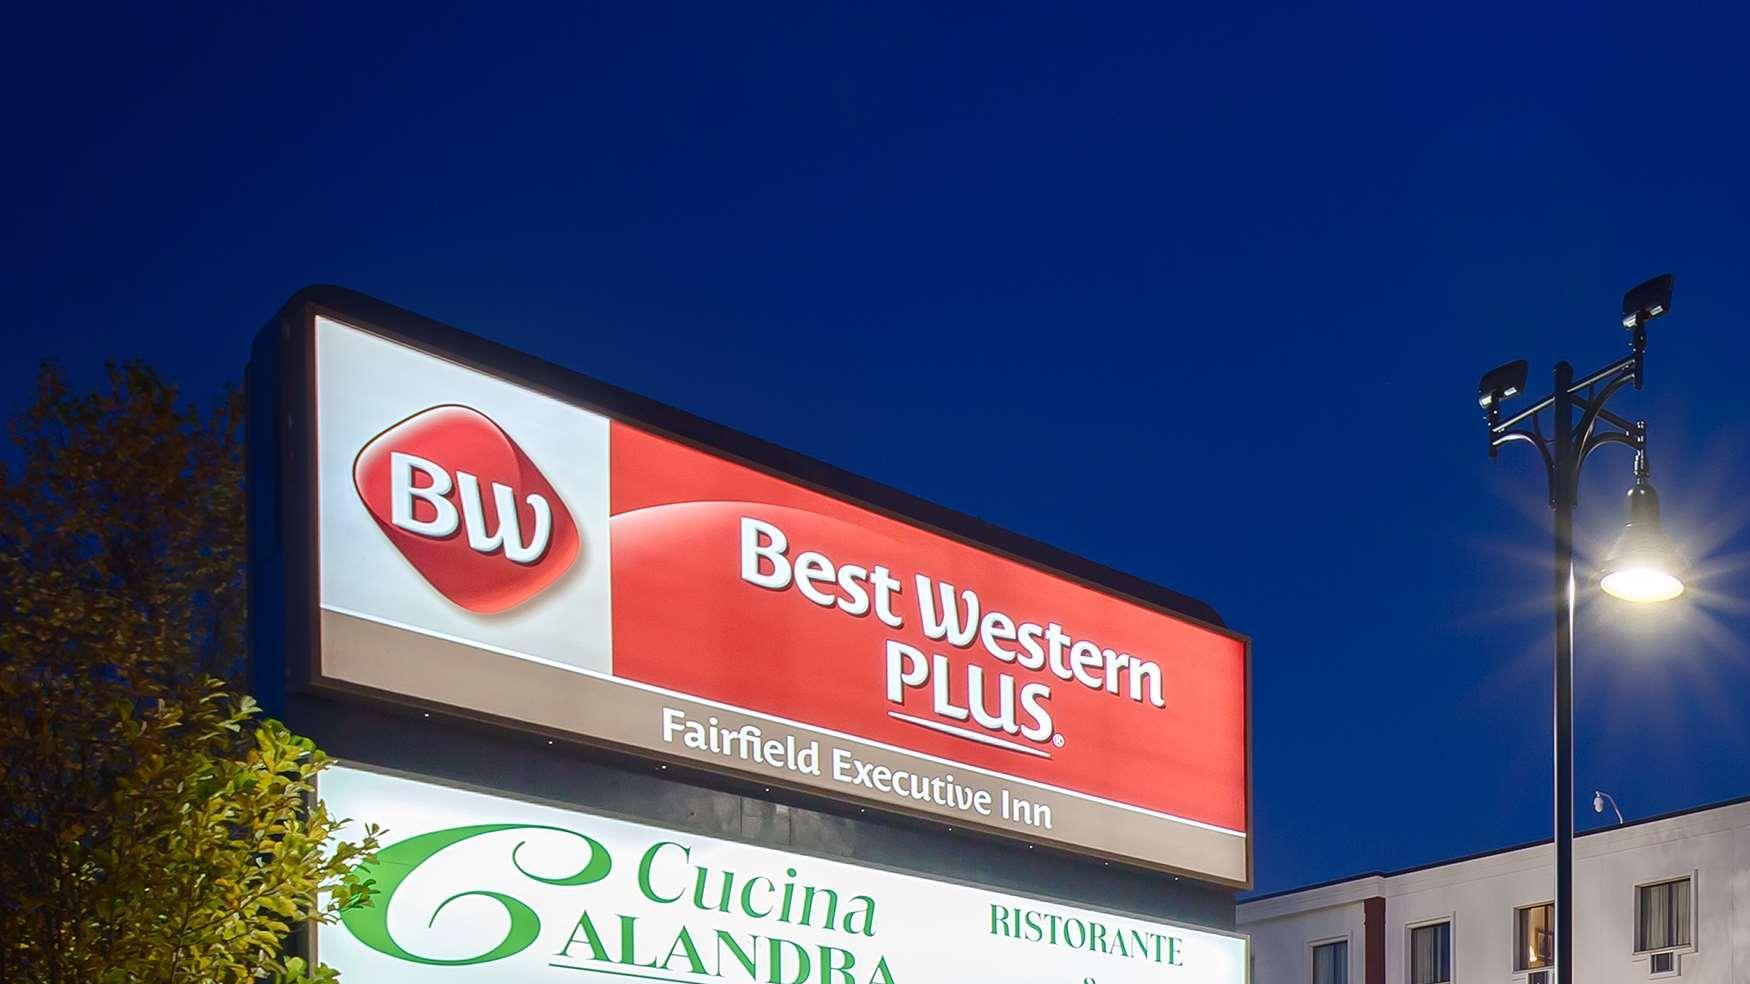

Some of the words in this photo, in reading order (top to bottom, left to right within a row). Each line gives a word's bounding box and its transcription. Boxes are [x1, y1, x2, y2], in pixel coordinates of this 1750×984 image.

[390, 451, 552, 564] BW
[740, 516, 903, 629] Best
[914, 573, 1166, 708] Western
[661, 707, 821, 777] Fairfield
[832, 749, 992, 816] Executive
[1002, 790, 1053, 830] Inn
[637, 840, 877, 938] Cucina
[989, 903, 1184, 967] RISTORANTE
